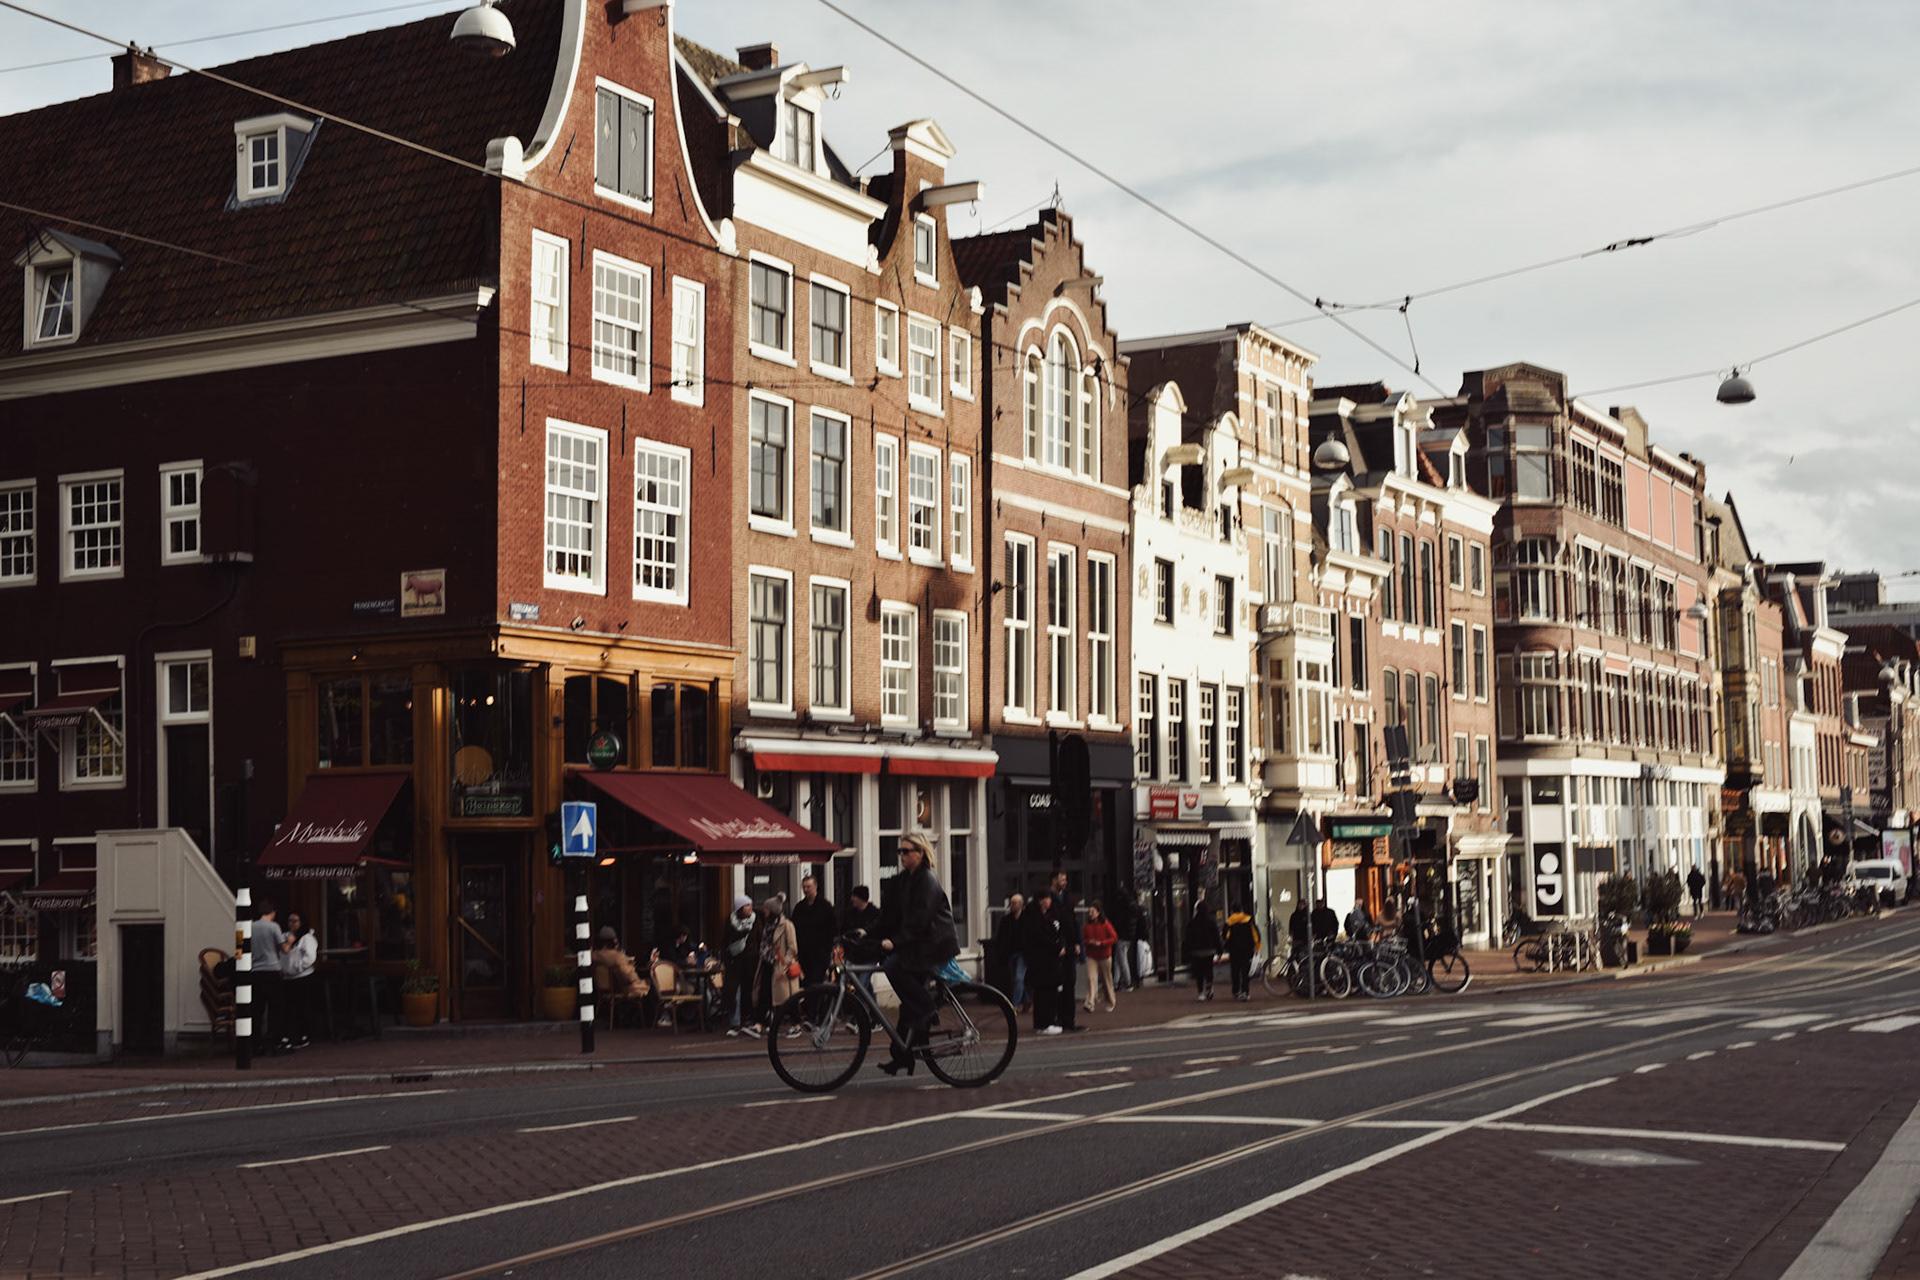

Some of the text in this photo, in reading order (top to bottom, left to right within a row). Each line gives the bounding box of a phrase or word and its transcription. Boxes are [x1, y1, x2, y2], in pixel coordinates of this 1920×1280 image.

[34, 714, 81, 729] Restaurant
[275, 819, 367, 846] Myrabelle
[266, 867, 284, 878] Bar
[295, 866, 354, 878] Restaurant
[32, 896, 83, 909] Restaurant
